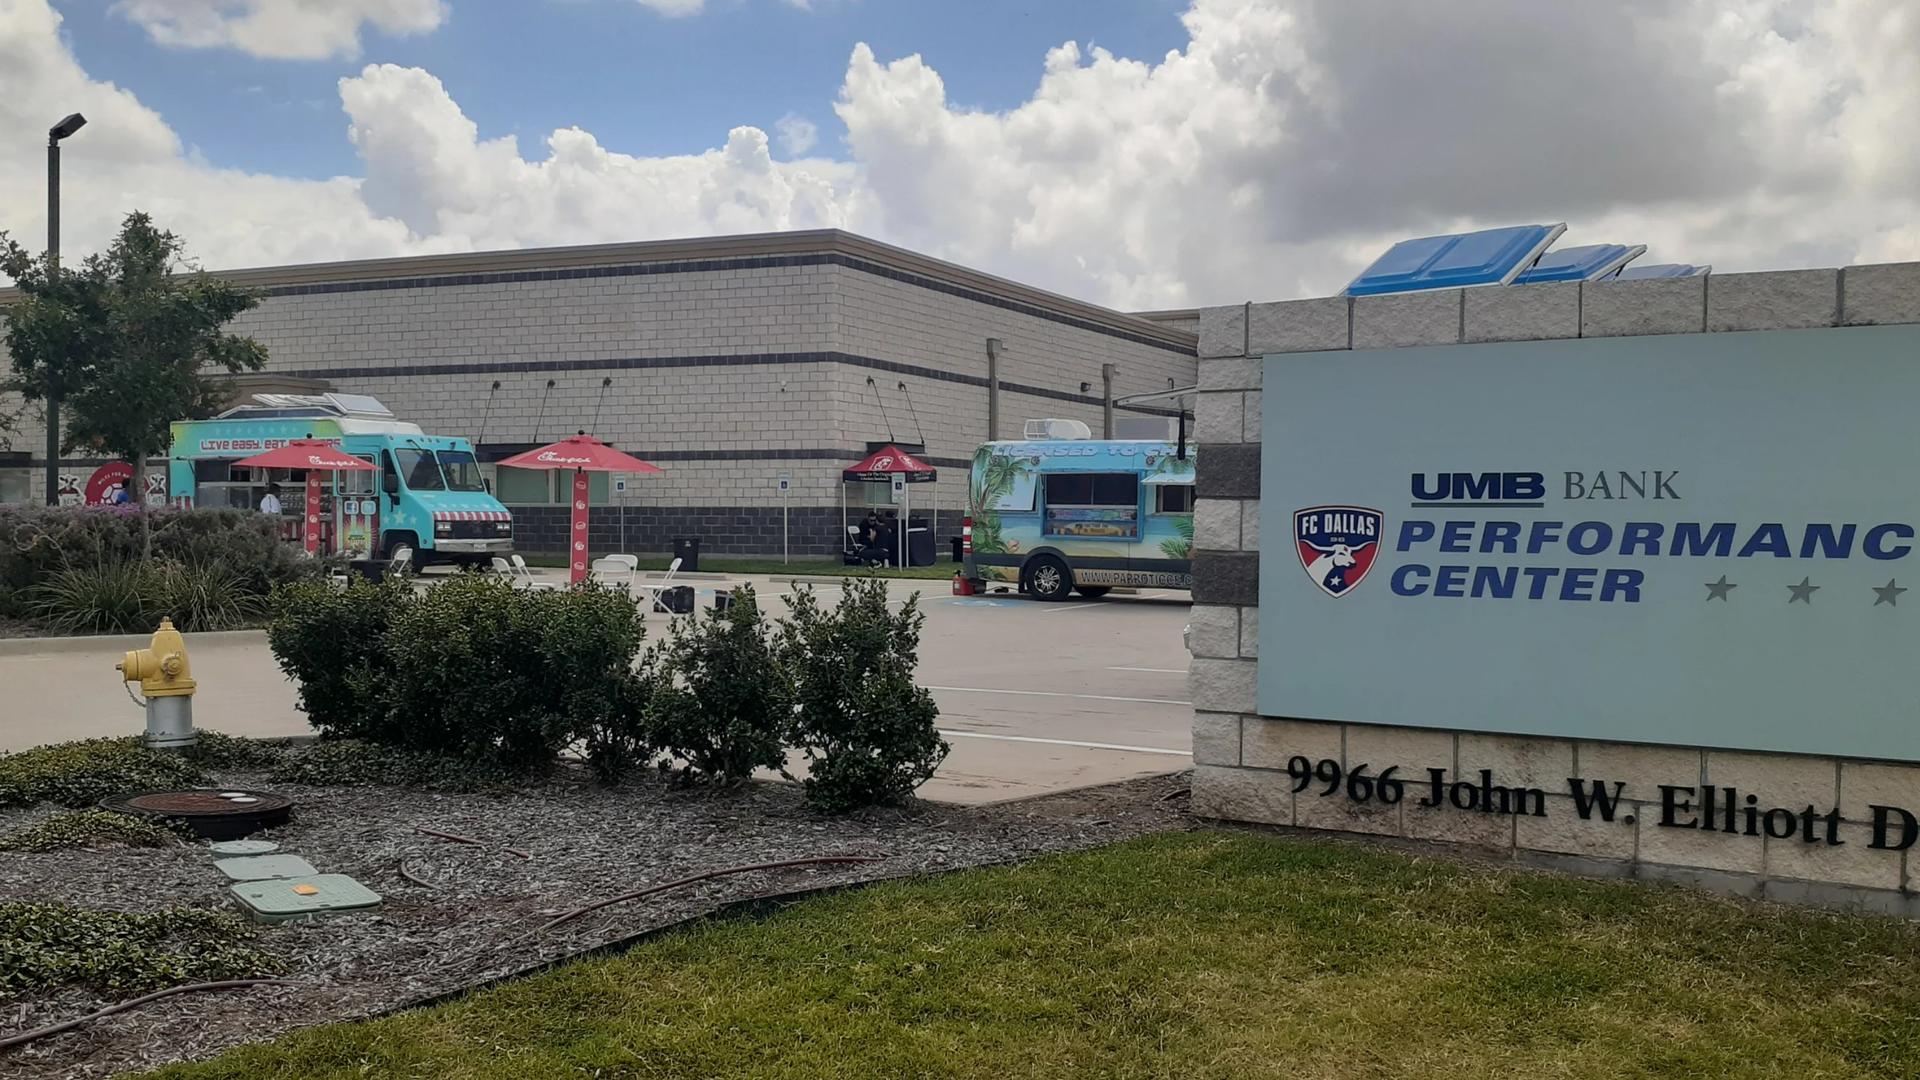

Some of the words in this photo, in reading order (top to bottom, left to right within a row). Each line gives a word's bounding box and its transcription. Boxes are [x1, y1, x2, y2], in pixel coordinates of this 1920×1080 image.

[1411, 472, 1546, 501] UMB
[1564, 470, 1682, 500] BANK
[1302, 515, 1318, 536] FC
[1324, 513, 1375, 536] DALLAS
[1396, 520, 1915, 561] PERFORMANC
[1390, 564, 1645, 603] CENTER
[1287, 755, 1404, 805] 9966
[1420, 767, 1548, 818] John
[1566, 777, 1636, 826] W.
[1658, 784, 1846, 847] Elliott
[1867, 804, 1919, 851] D
